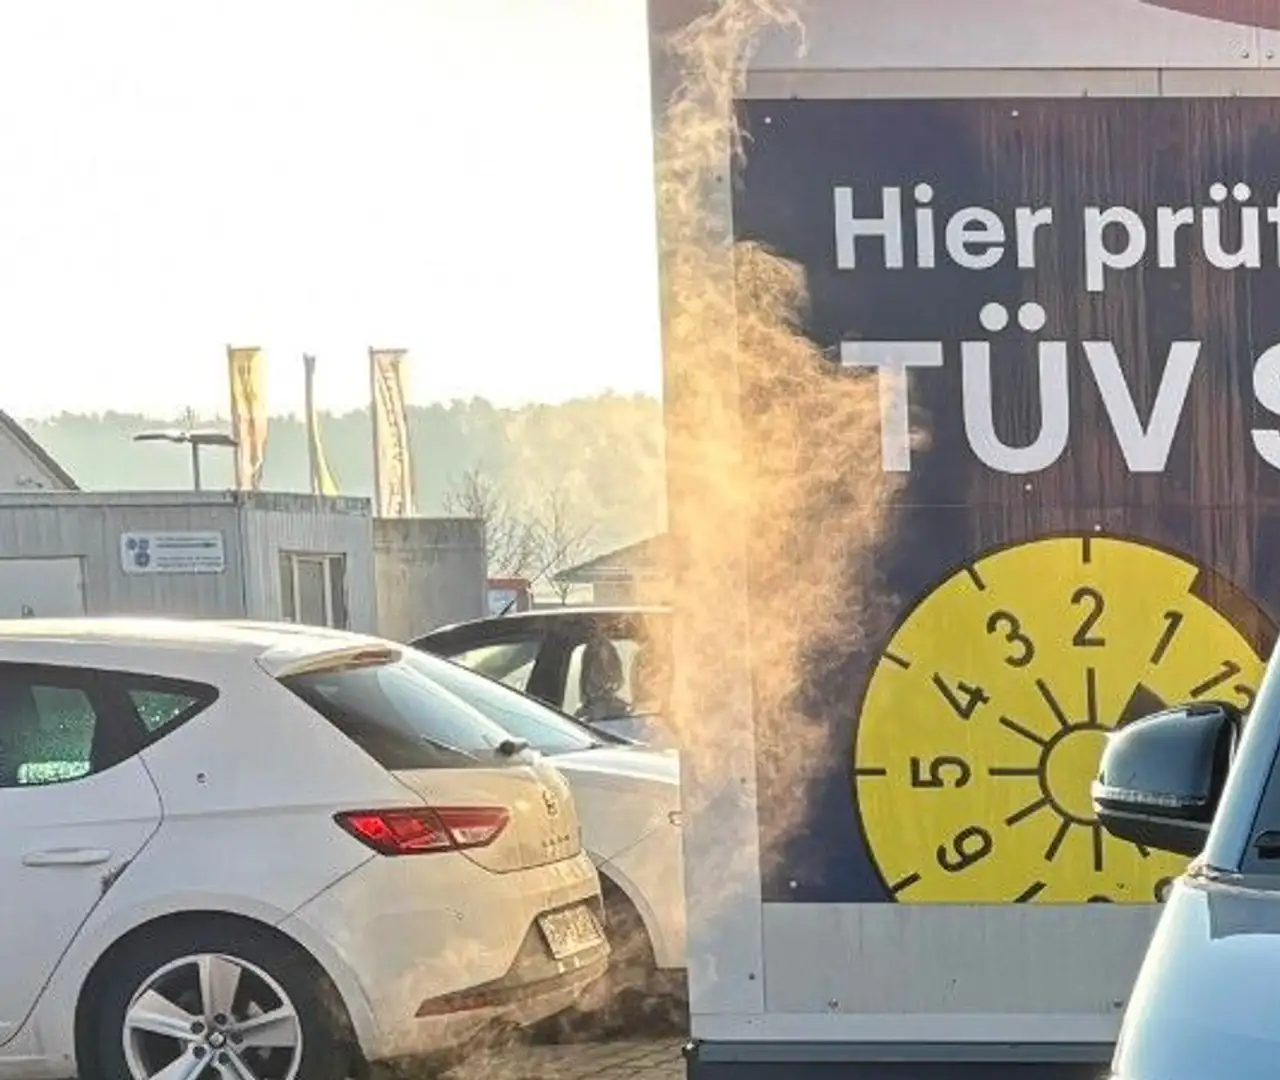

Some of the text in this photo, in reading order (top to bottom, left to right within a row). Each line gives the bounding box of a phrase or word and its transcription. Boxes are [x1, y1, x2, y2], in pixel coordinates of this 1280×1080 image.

[834, 184, 1051, 269] Hier
[840, 303, 1201, 474] TÜV
[986, 611, 1035, 668] 3
[1070, 587, 1106, 647] 2
[1150, 609, 1184, 665] 1
[932, 672, 990, 720] 4
[910, 755, 971, 789] 5
[936, 825, 993, 874] 6
